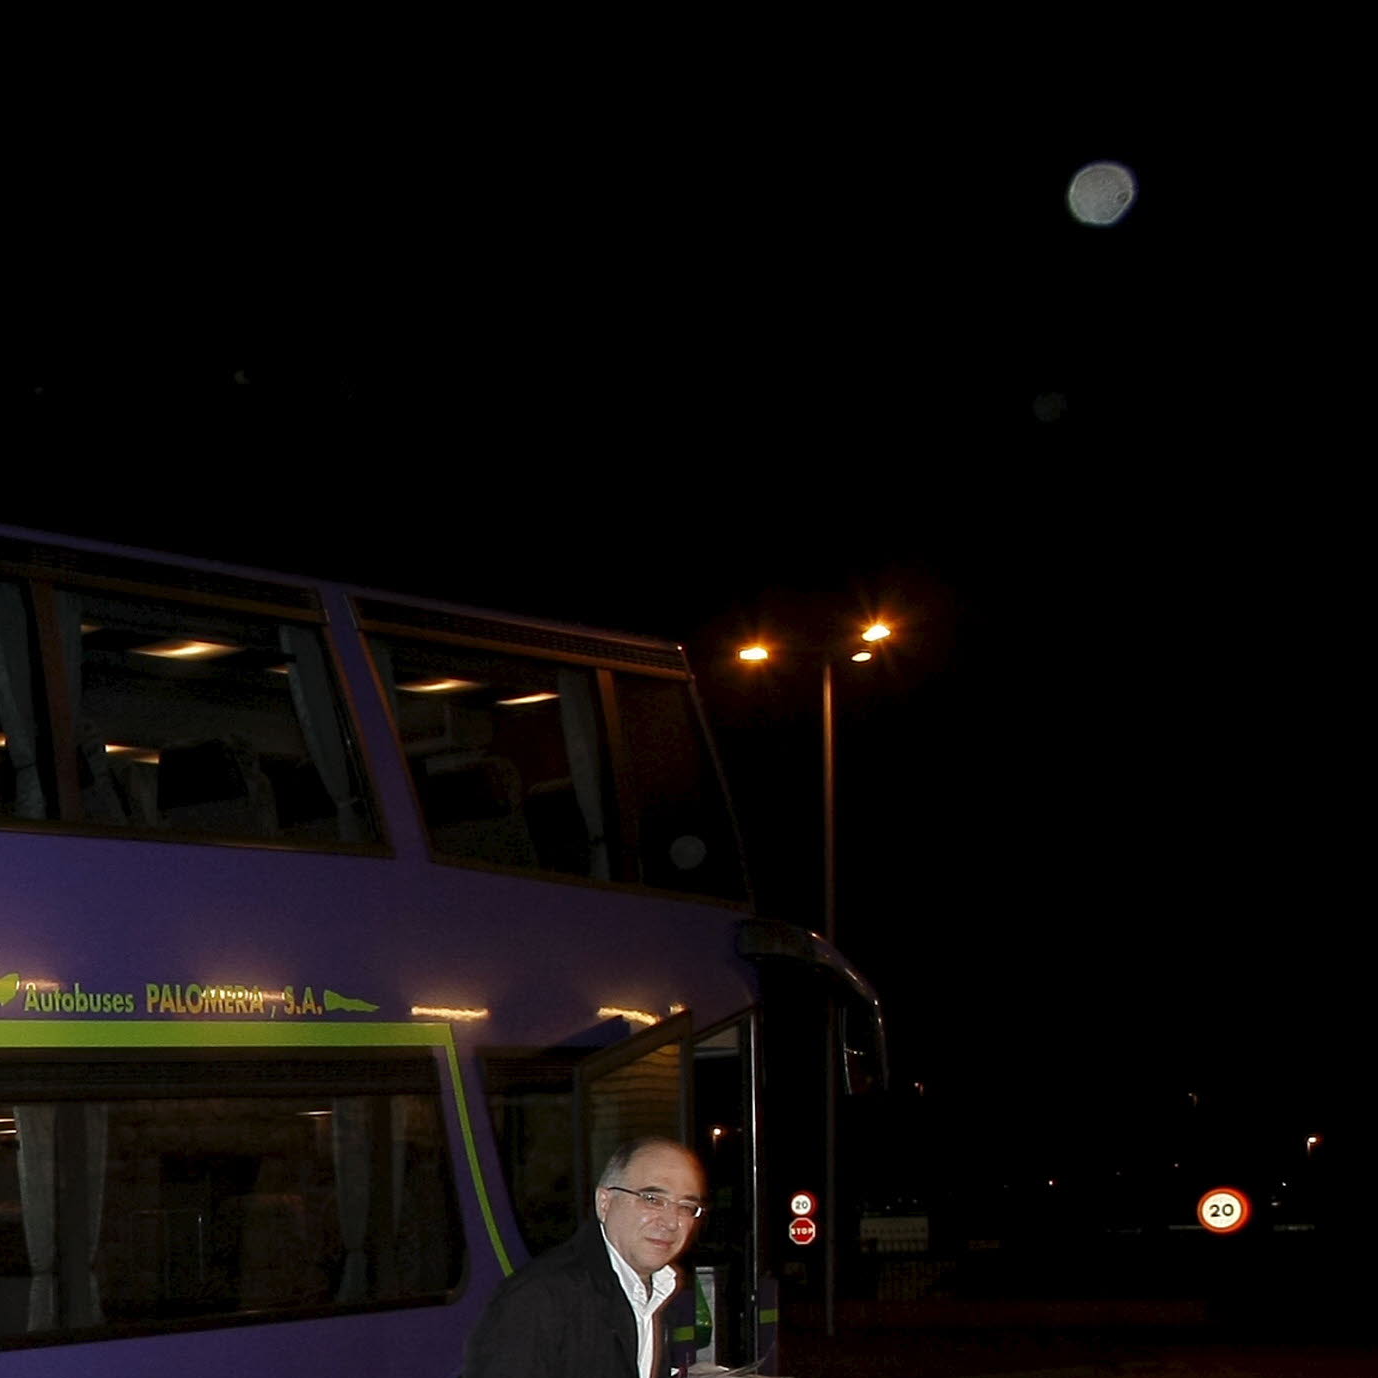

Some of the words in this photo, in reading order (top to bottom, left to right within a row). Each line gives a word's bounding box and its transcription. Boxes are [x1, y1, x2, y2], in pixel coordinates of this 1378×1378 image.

[24, 983, 135, 1013] Autobuses
[284, 985, 323, 1015] S.A.
[795, 1200, 808, 1210] 20
[1209, 1203, 1234, 1217] 20
[791, 1227, 813, 1235] STOP
